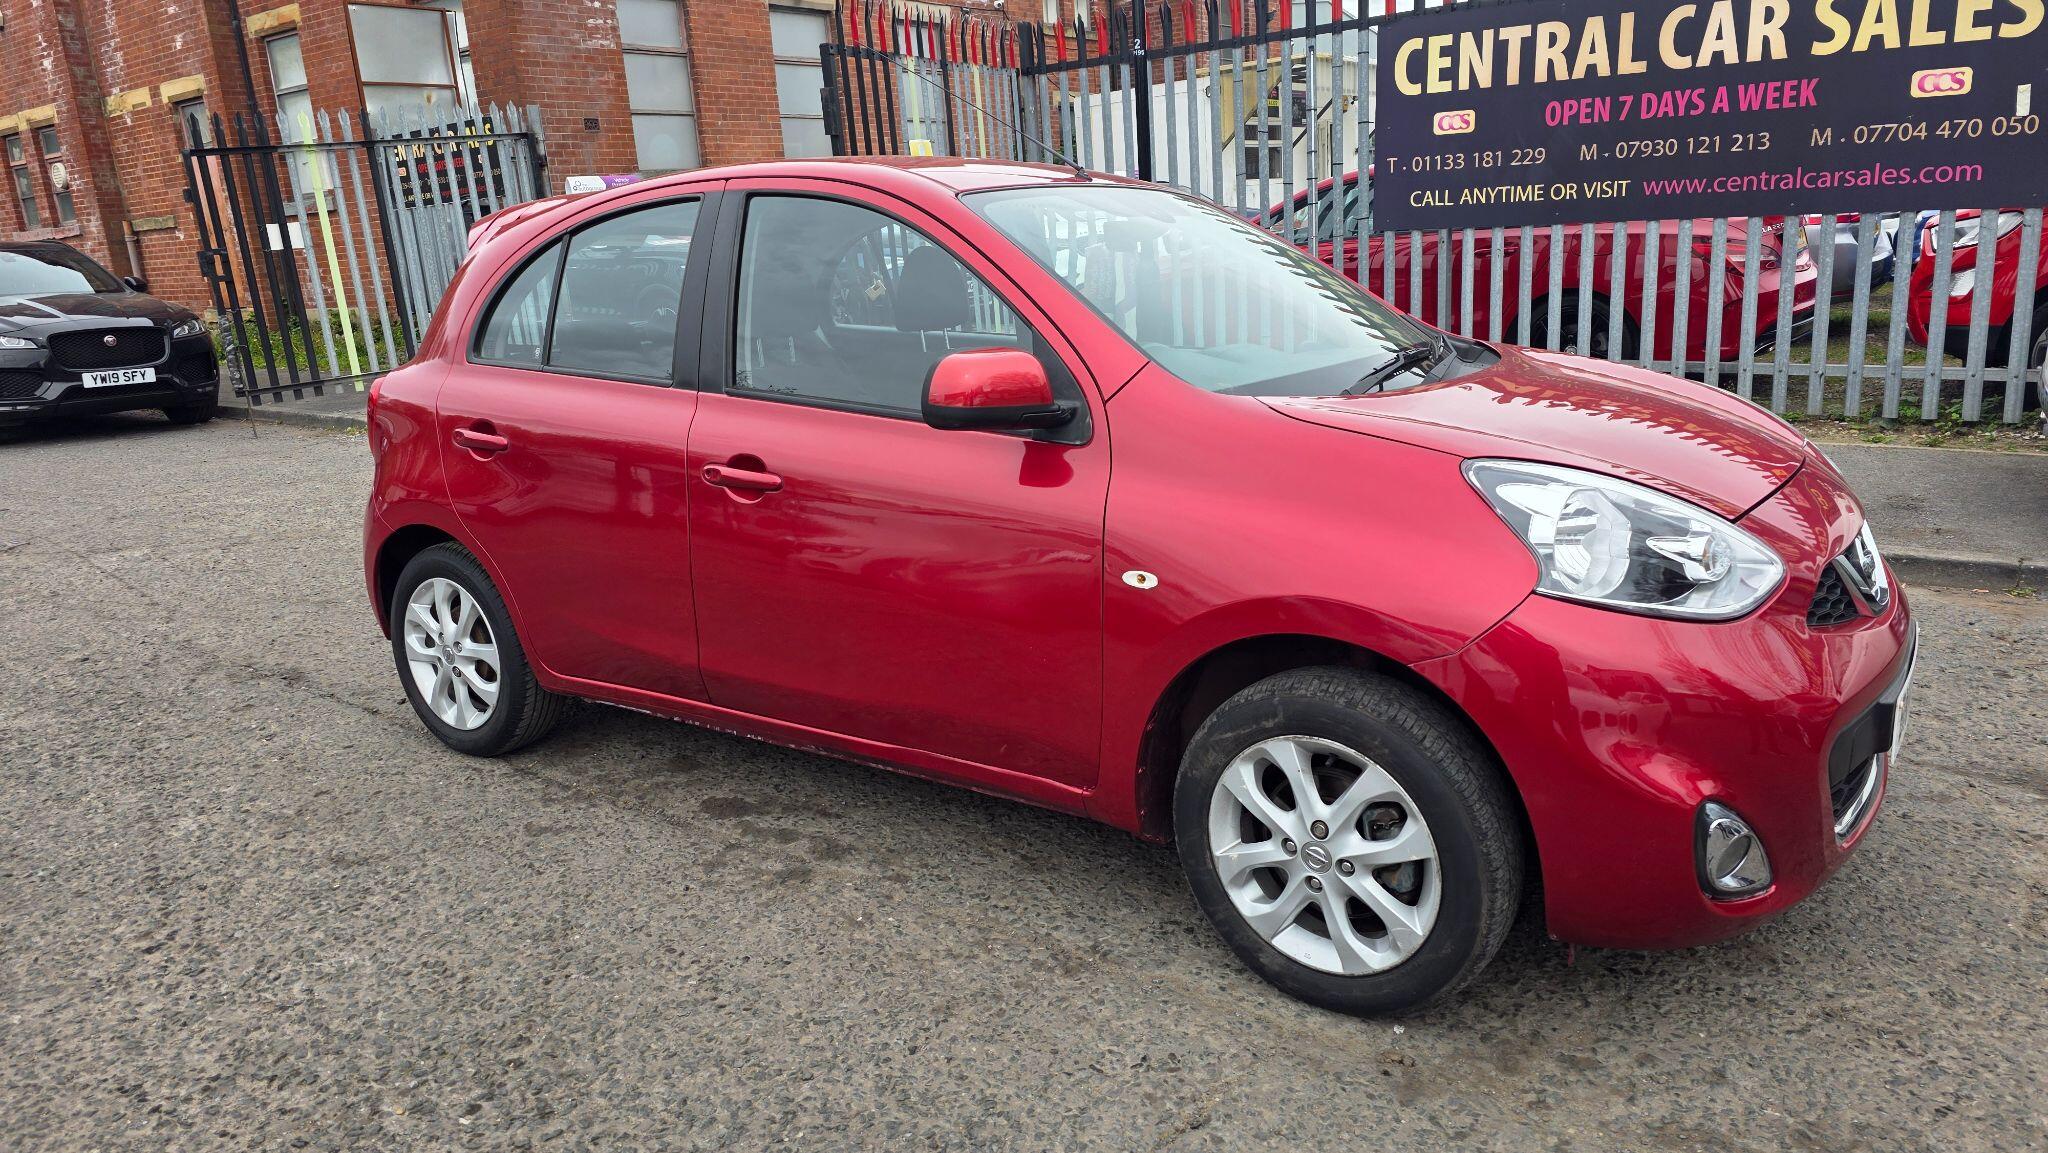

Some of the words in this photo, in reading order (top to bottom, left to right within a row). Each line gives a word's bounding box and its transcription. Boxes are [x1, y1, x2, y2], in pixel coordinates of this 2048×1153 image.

[1134, 38, 1141, 50] 2
[1394, 11, 1648, 96] CENTRAL
[1658, 0, 1791, 70] CAR
[1810, 0, 2046, 56] SALES
[1917, 71, 1966, 94] CCS
[1544, 95, 1611, 127] OPEN
[1618, 94, 1634, 121] 7
[1640, 87, 1706, 120] DAYS
[1710, 85, 1730, 114] A
[1737, 77, 1820, 111] WEEK
[1437, 113, 1471, 131] CCS
[1853, 122, 1928, 145] 07704
[1935, 118, 1983, 139] 470
[1991, 114, 2040, 137] 050
[1615, 137, 1679, 160] 07930
[1686, 135, 1720, 155] 121
[1730, 131, 1770, 152] 213
[1411, 153, 1465, 173] 01133
[1472, 150, 1502, 168] 181
[1509, 147, 1546, 168] 229
[1409, 188, 1455, 208] CALL
[1459, 183, 1545, 206] ANYTIME
[1550, 182, 1578, 201] OR
[1583, 178, 1632, 200] VISIT
[1642, 162, 1983, 197] www.centralcarsales.com
[91, 372, 120, 385] YW19
[122, 370, 146, 382] SFY
